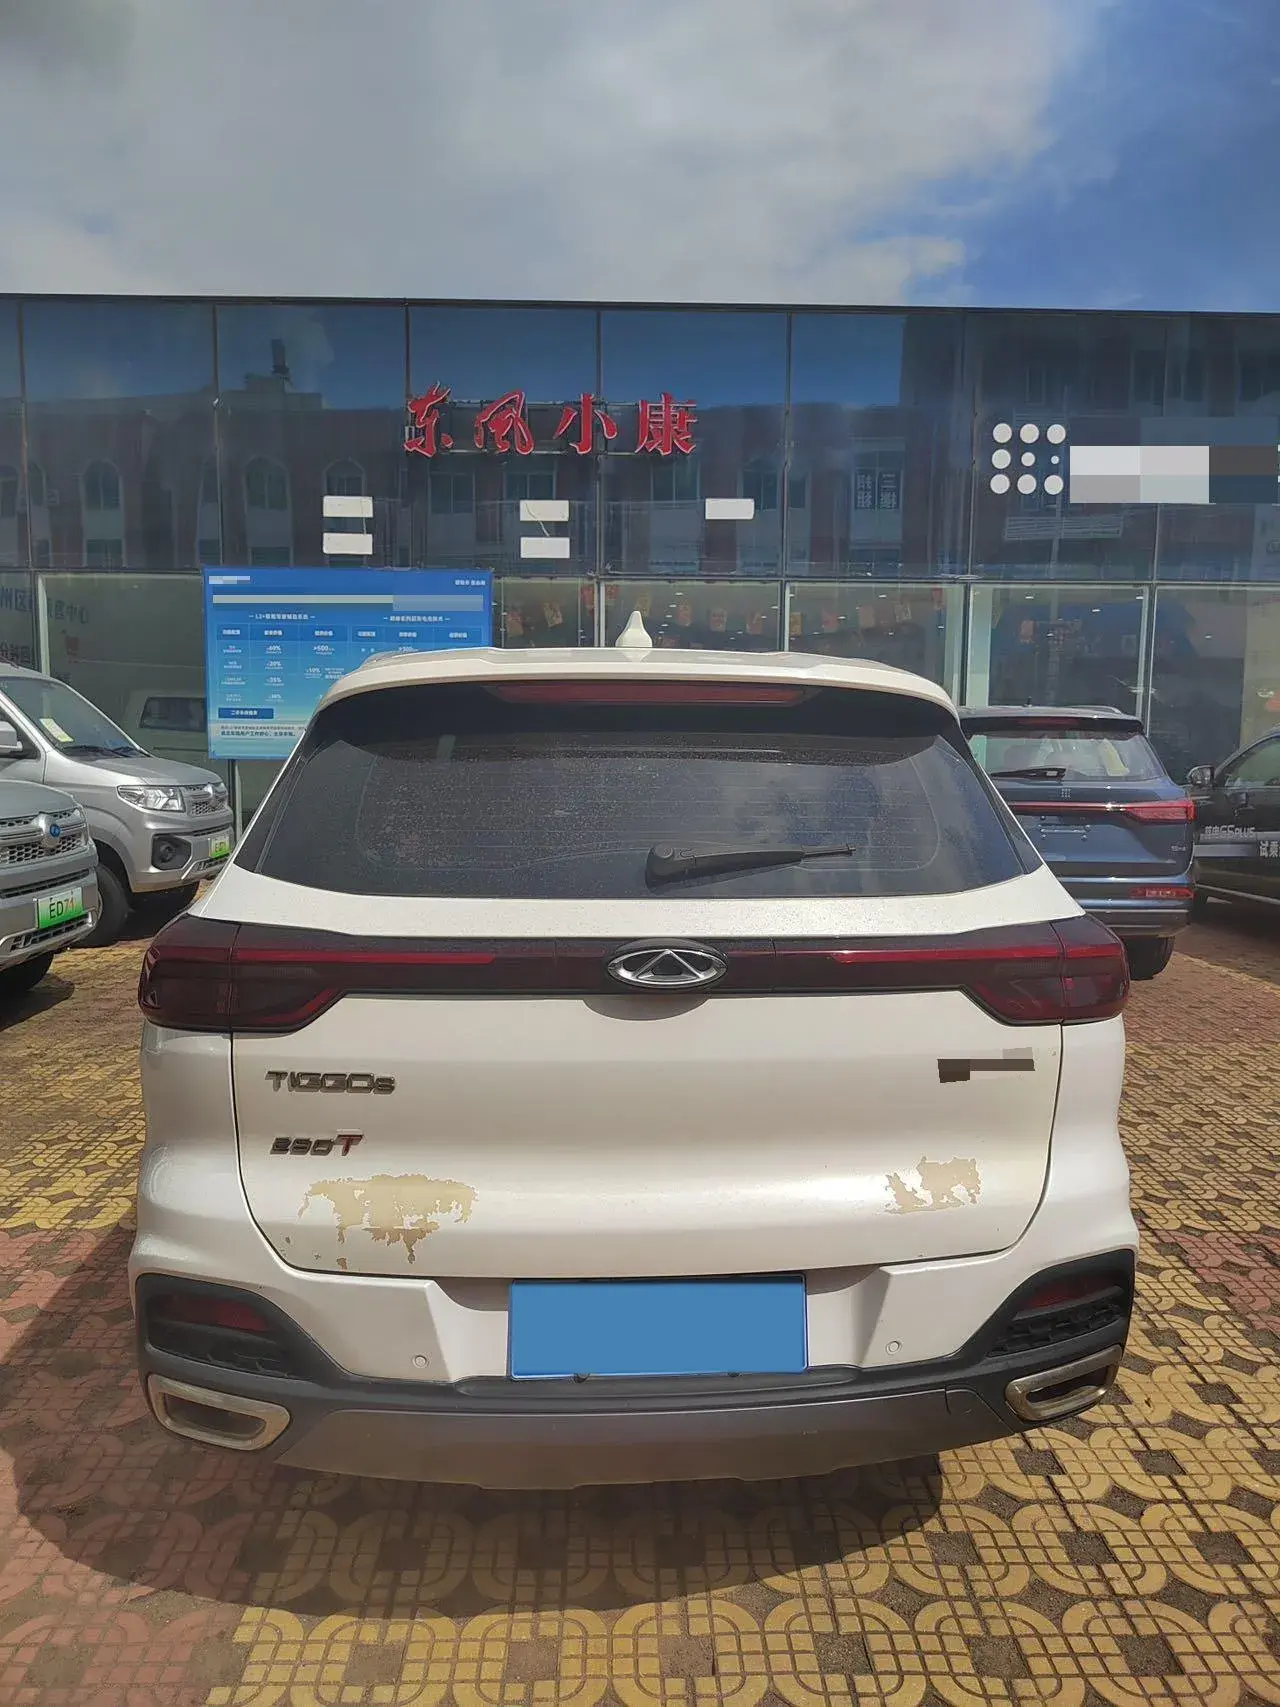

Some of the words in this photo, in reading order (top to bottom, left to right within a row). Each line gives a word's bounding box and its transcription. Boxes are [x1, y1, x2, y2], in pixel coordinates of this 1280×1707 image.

[403, 381, 697, 458] 东风小康
[1259, 840, 1280, 858] 试乘
